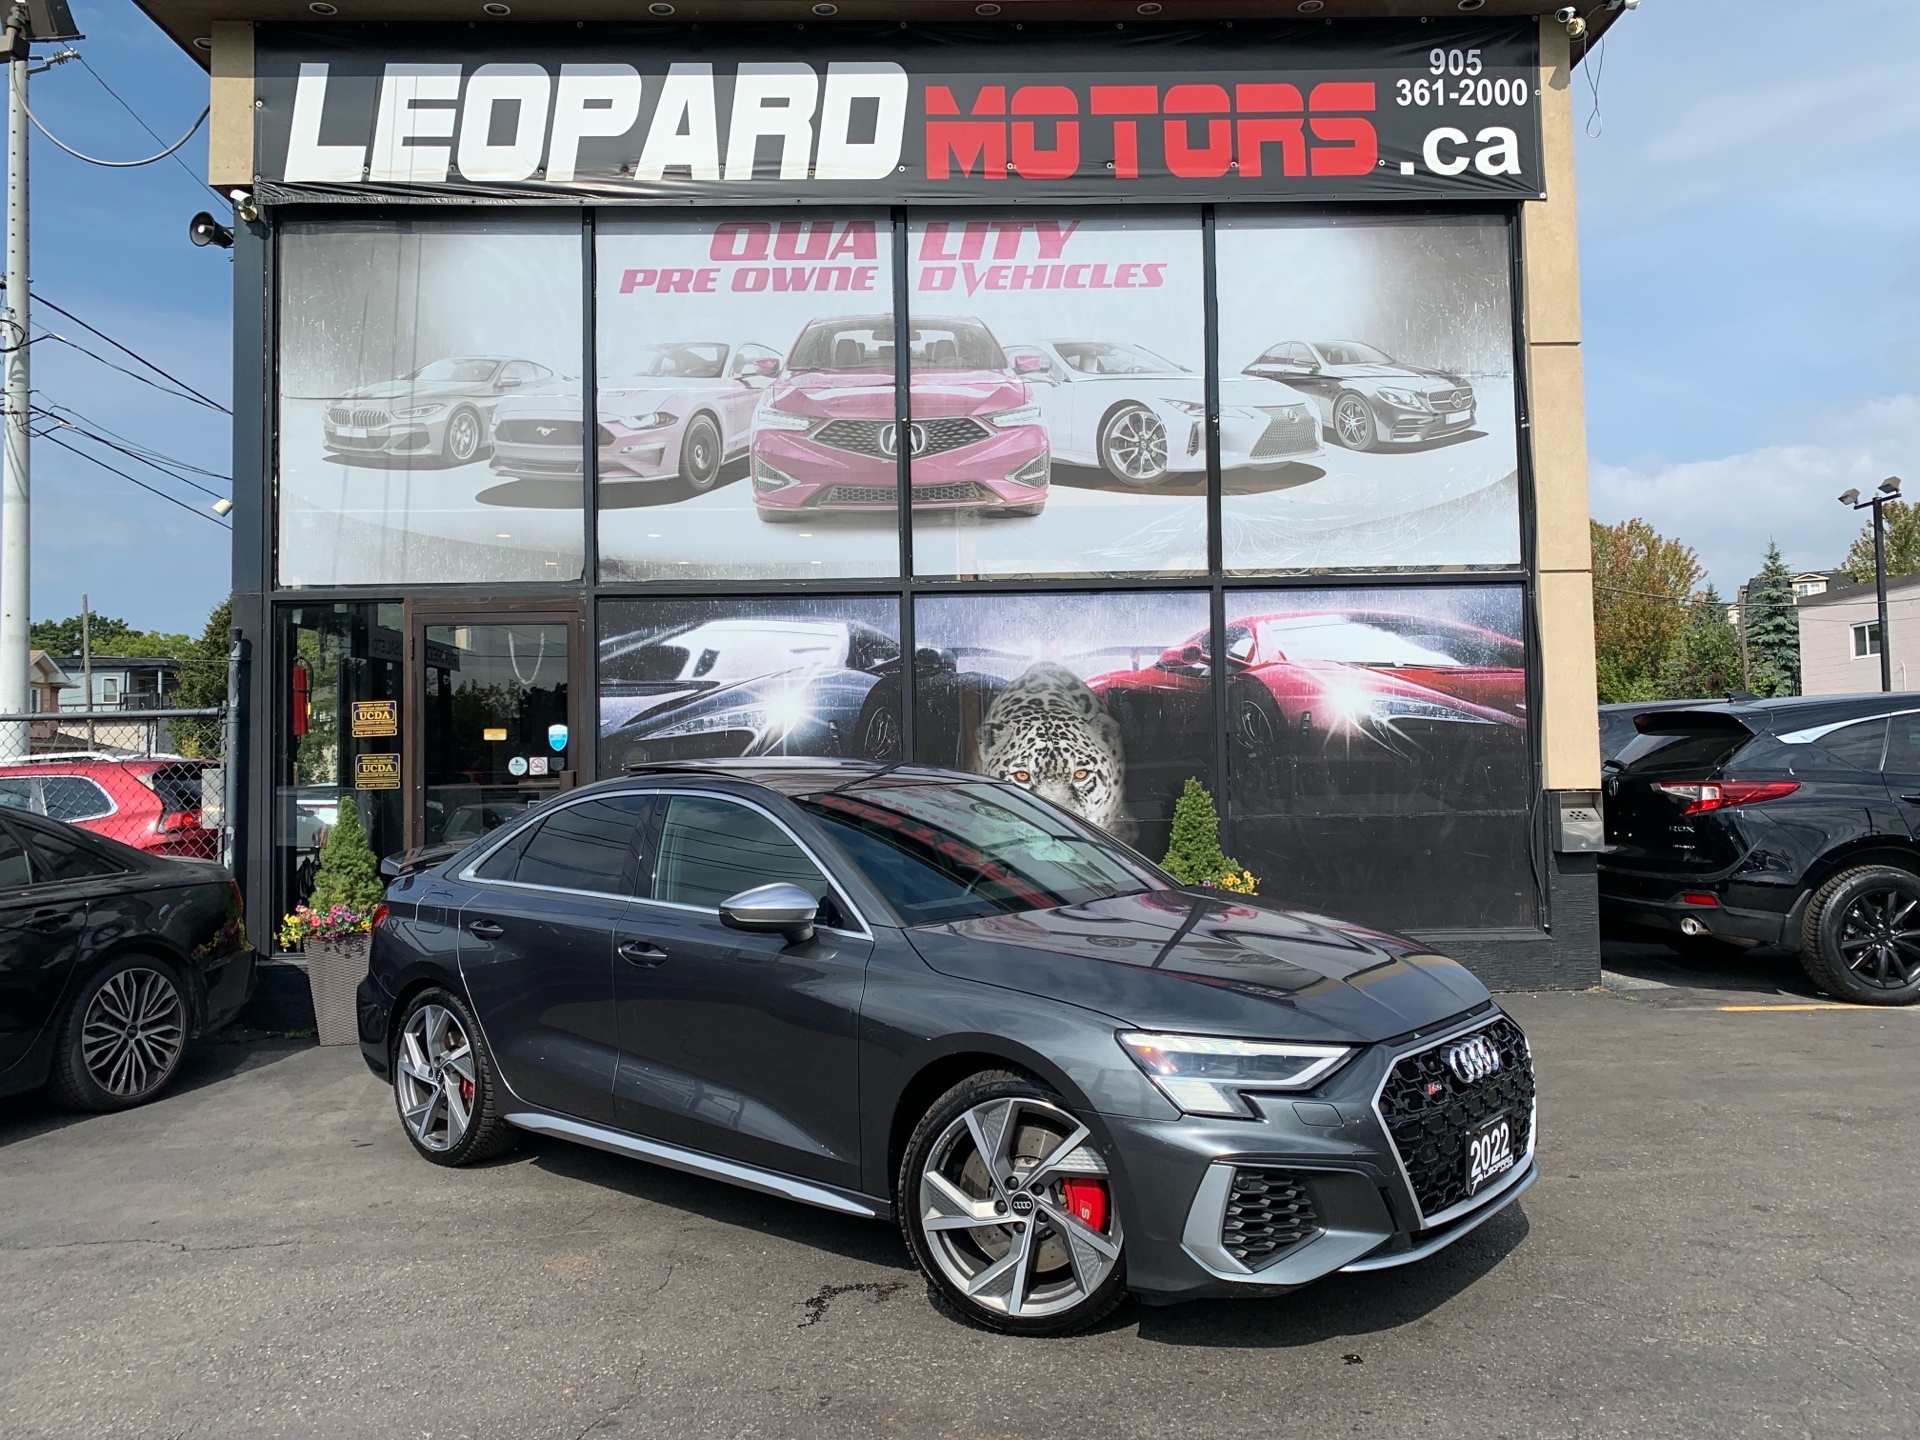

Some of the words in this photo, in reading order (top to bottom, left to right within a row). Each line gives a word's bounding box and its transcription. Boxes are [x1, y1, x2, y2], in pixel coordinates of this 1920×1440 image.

[1429, 48, 1482, 76] 905
[1395, 78, 1528, 107] 361-2000
[284, 61, 909, 183] LEOPARD
[925, 81, 1378, 180] MOTORS
[1400, 126, 1522, 176] .ca
[619, 268, 721, 294] PRE
[359, 711, 390, 720] UCDA
[362, 764, 394, 773] UCDA
[1470, 1122, 1510, 1178] 2022
